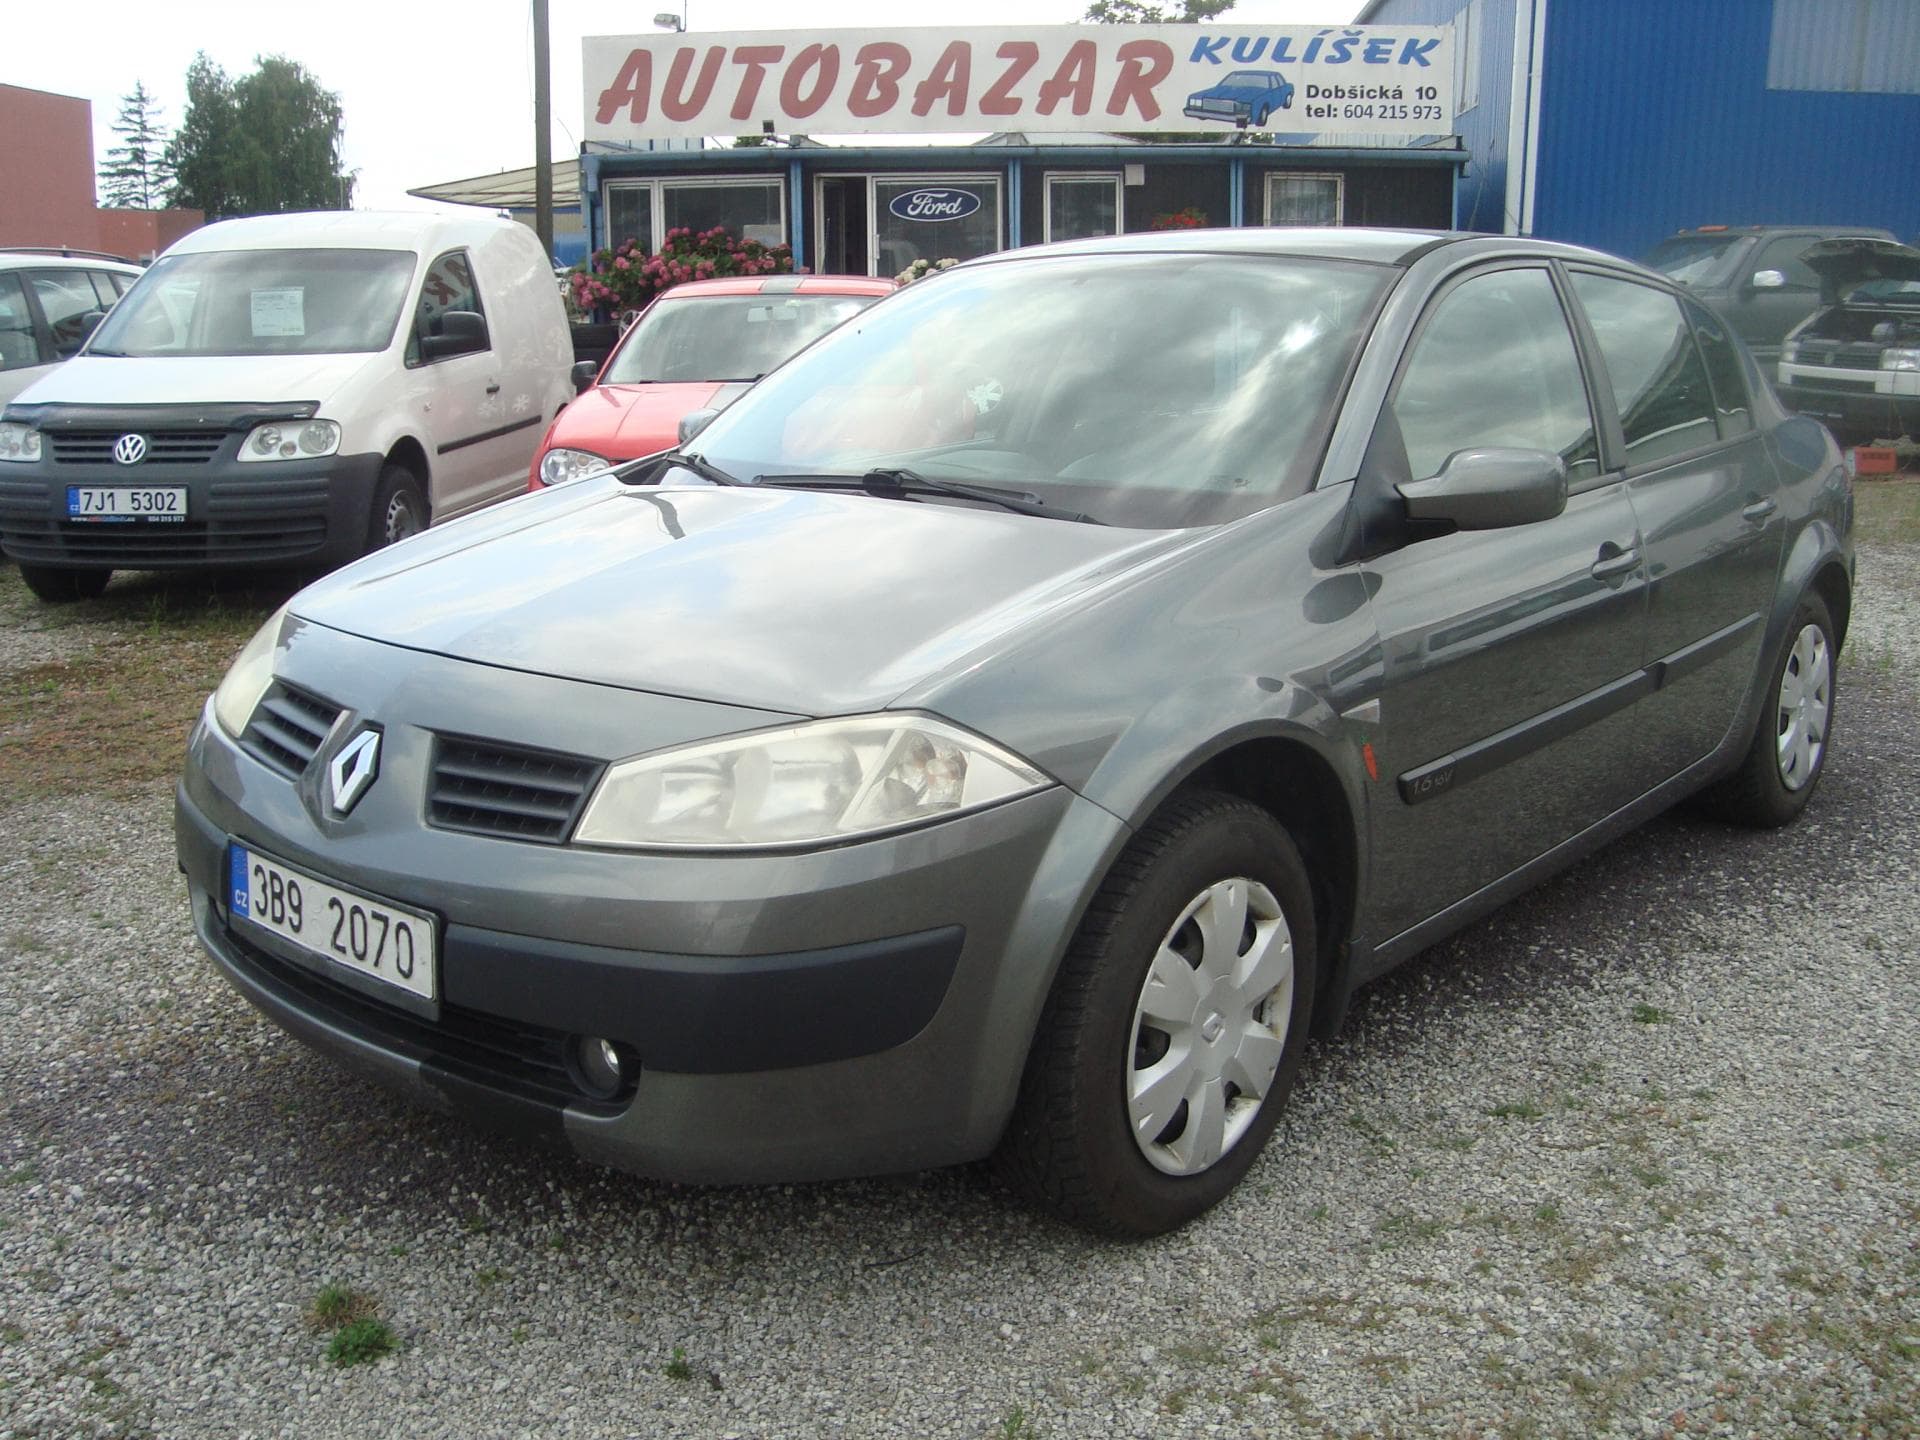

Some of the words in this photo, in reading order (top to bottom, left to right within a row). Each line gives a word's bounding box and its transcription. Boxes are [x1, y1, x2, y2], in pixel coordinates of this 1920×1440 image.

[1188, 29, 1441, 67] KULÍŠEK
[595, 39, 1174, 124] AUTOBAZAR
[1305, 83, 1403, 100] Dobšická
[1415, 86, 1438, 101] 10
[1305, 103, 1338, 119] tel:
[1343, 104, 1374, 119] 604
[1378, 104, 1408, 120] 215
[1412, 105, 1443, 121] 973
[907, 192, 963, 215] Ford
[83, 492, 115, 511] 7J1
[130, 492, 177, 511] 5302
[234, 889, 248, 908] CZ
[254, 864, 303, 933] 3B9
[328, 896, 414, 979] 2070
